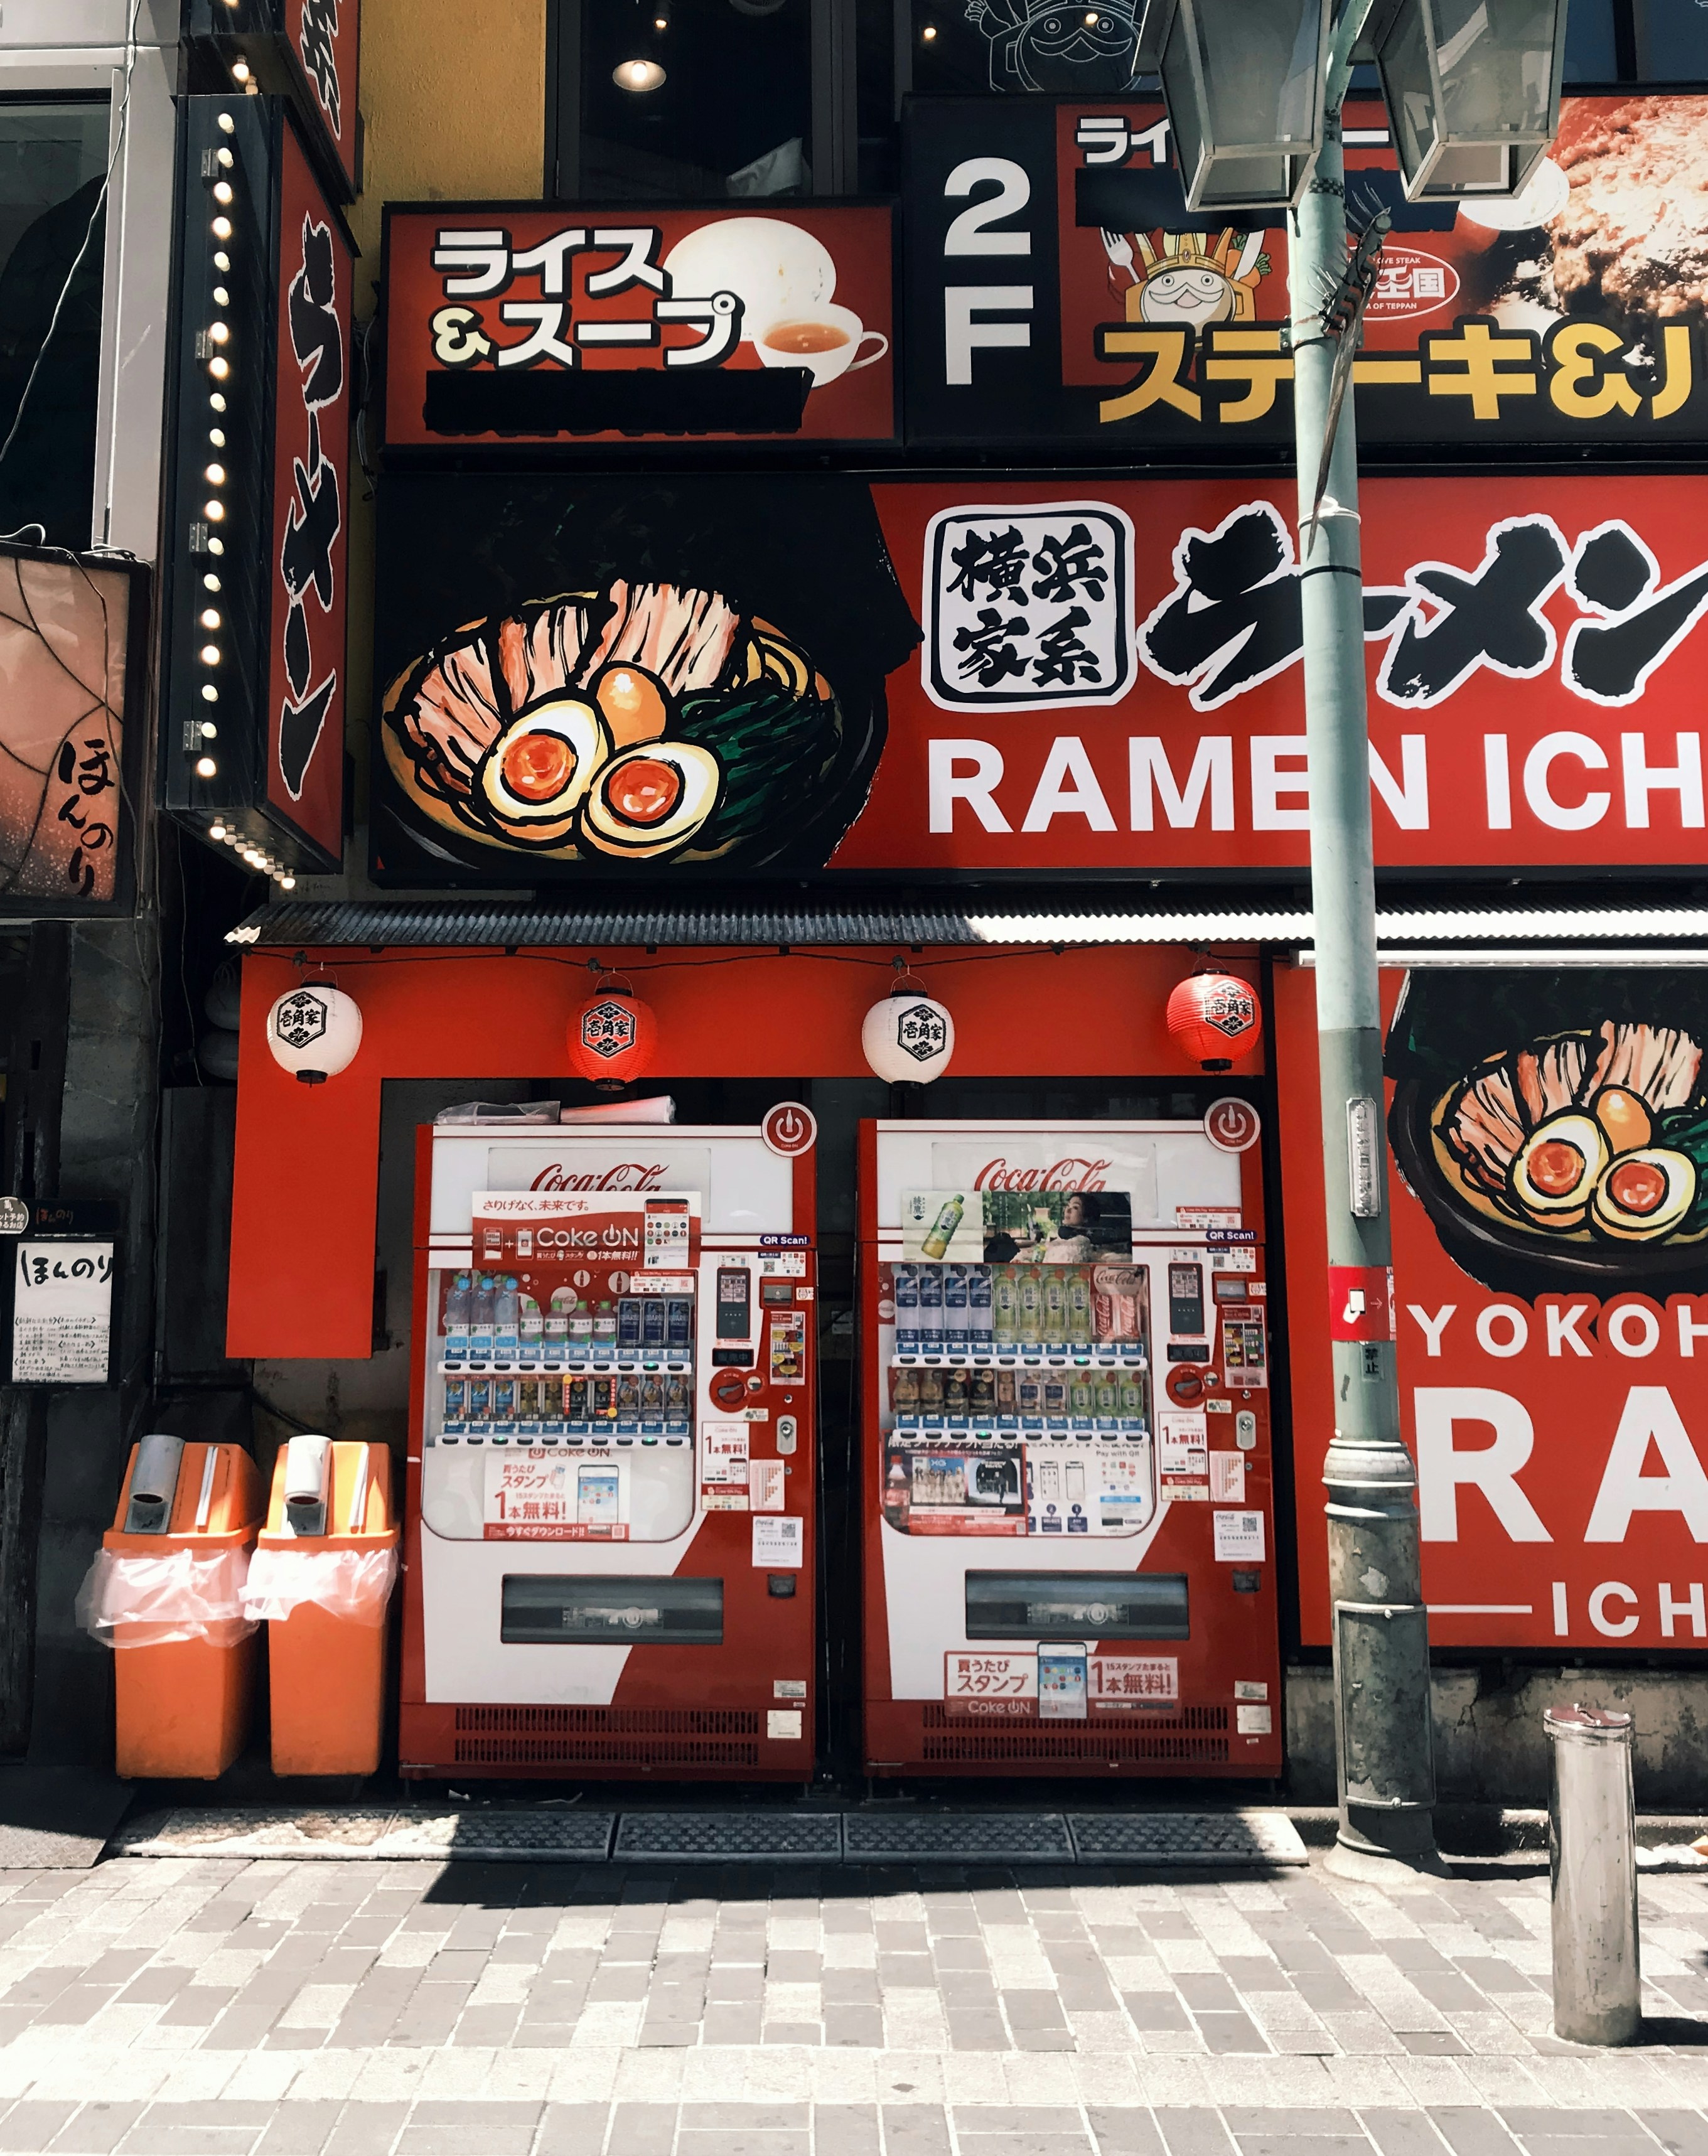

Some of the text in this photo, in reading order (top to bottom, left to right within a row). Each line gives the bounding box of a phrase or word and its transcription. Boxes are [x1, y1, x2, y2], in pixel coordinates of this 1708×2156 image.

[433, 228, 665, 295] ライス
[946, 523, 1109, 606] 横浜
[950, 606, 1103, 687] 家系
[929, 735, 1430, 834] RAMEN
[58, 738, 115, 897] ほんのり
[1211, 1000, 1253, 1016] 壱角家
[281, 1009, 321, 1026] 壱角家
[586, 1020, 630, 1036] 壱角家
[903, 1022, 943, 1041] 壱角家
[482, 1199, 590, 1212] さりげなく、未来です。
[537, 1227, 598, 1247] Coke
[763, 1236, 808, 1245] QR Scan!
[1210, 1231, 1254, 1240] QR Scan!
[20, 1250, 114, 1287] ほんのり
[1407, 1304, 1708, 1358] YOKOH
[547, 1448, 584, 1457] Coke
[503, 1464, 535, 1474] 買うたび
[1414, 1386, 1708, 1543] RA
[501, 1474, 549, 1489] スタンプ
[506, 1526, 585, 1537] 今すぐダウンロード!!
[1552, 1581, 1707, 1638] ICH
[957, 1659, 1010, 1673] 買うたび
[957, 1673, 1029, 1693] スタンプ
[968, 1700, 1006, 1714] Coke
